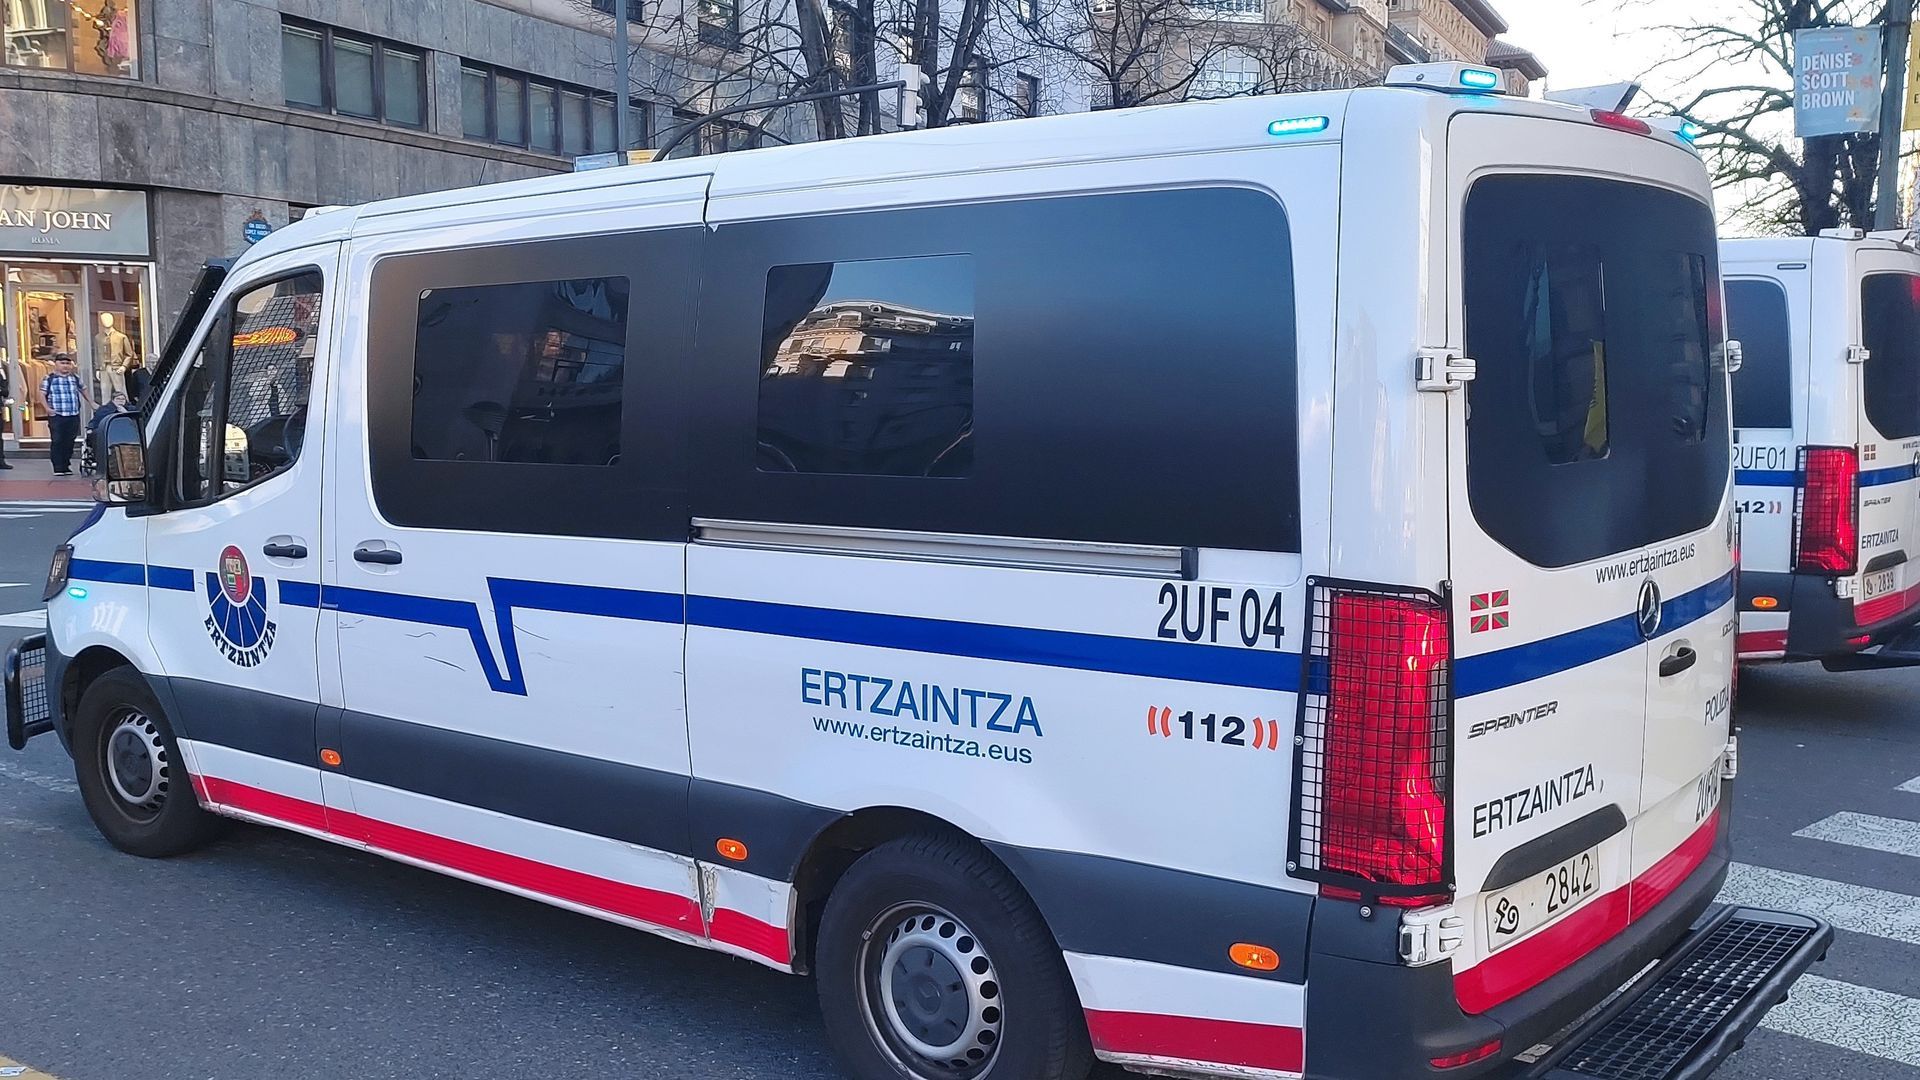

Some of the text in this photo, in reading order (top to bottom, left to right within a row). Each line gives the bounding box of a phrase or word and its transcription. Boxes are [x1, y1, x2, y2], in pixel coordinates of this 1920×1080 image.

[1801, 52, 1853, 71] DENISE
[1801, 71, 1849, 91] SCOTT
[1801, 90, 1855, 110] BROWN
[40, 210, 112, 233] JOHN
[31, 236, 61, 244] ROMA
[1861, 528, 1899, 549] ERTZAINTZA
[1595, 543, 1696, 584] www.ertzaintza.eus
[1878, 571, 1894, 593] 2839
[203, 614, 278, 668] ERTZAINTZA
[801, 667, 1043, 737] ERTZAINTZA
[1467, 700, 1558, 739] SPRINTER
[812, 716, 1033, 764] www.ertzaintza.eus
[1473, 763, 1595, 839] ERTZAINTZA
[1545, 853, 1592, 914] 2842
